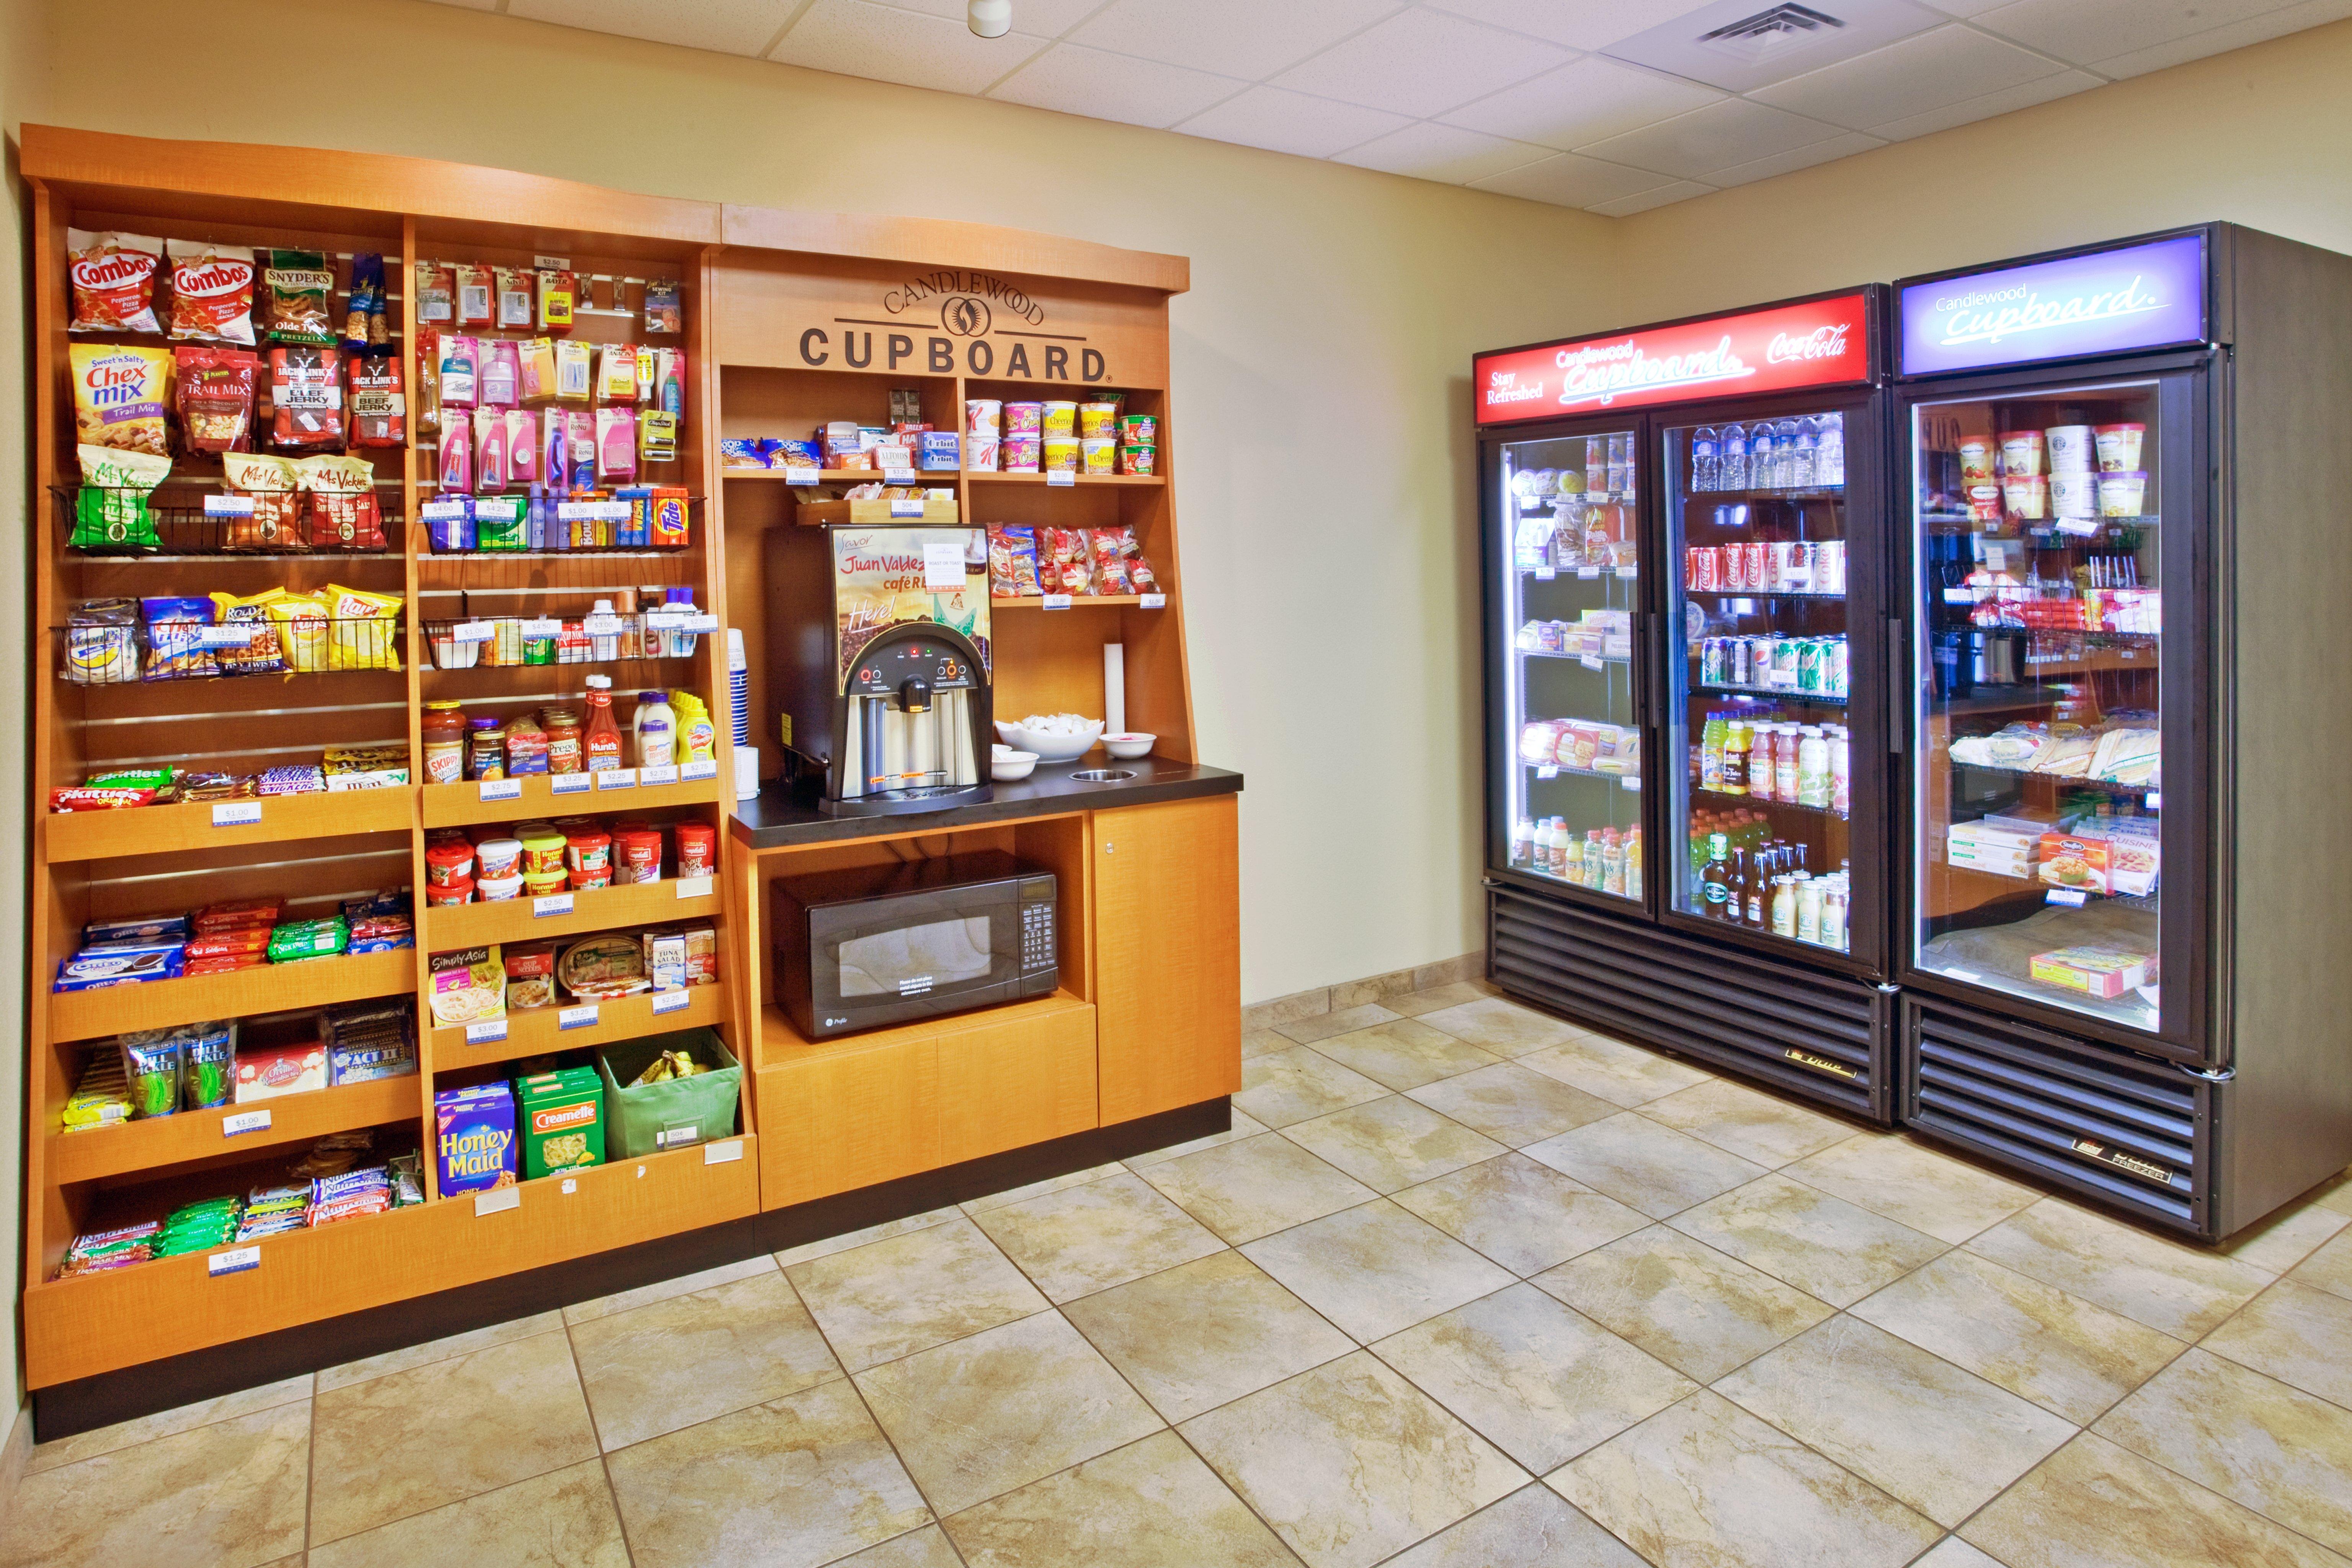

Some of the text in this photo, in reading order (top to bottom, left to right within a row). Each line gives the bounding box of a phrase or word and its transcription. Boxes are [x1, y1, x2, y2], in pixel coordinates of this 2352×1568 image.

[77, 256, 152, 286] Combos
[268, 270, 330, 284] SNYDER'S
[177, 265, 248, 292] Combos
[884, 271, 1044, 326] CANDLEWOOD
[1935, 283, 2027, 312] Candlewood
[208, 301, 237, 311] Pepperoni
[275, 322, 299, 331] Olde
[281, 333, 322, 342] PRETZELS
[1767, 323, 1851, 365] Coca-Cola
[124, 355, 145, 364] Salty
[799, 328, 1105, 382] CUPBOARD
[1556, 340, 1633, 368] Candlewood
[86, 364, 148, 388] Chex
[352, 375, 399, 385] JACK LINK'S
[1491, 373, 1516, 388] Stay
[93, 379, 145, 405] mix
[186, 383, 247, 396] TRAIL MIX
[1487, 383, 1543, 405] Refreshed
[113, 405, 155, 417] Trail Mix
[969, 406, 983, 431] K
[1050, 416, 1072, 425] Cheerios
[928, 439, 956, 448] Orbit
[881, 451, 908, 460] ALTOIDS
[980, 442, 997, 466] K
[336, 469, 367, 490] Vickie's
[217, 498, 241, 506] $2.50
[486, 504, 506, 512] $4.25
[661, 500, 684, 532] Tide
[1588, 531, 1608, 540] Raisin
[840, 534, 873, 555] Savor
[840, 555, 879, 574] Juan
[1726, 547, 1740, 586] Coca-Cola
[1746, 546, 1759, 586] Coca-Cola
[848, 596, 896, 631] Here!
[464, 627, 484, 635] $1.00
[296, 640, 325, 649] Classic
[591, 742, 618, 751] Hunt's
[691, 735, 712, 746] French's
[549, 743, 576, 755] Prego
[431, 755, 459, 772] SKIPPY
[2038, 754, 2090, 769] CHEESEBURGER
[94, 769, 161, 783] Skittles
[436, 765, 461, 781] Natural
[225, 809, 248, 817] $1.00
[1964, 832, 1985, 841] CUISINE
[2076, 829, 2157, 851] LEAN CUISINE
[542, 847, 564, 858] Hormel
[1963, 846, 1983, 855] CUISINE
[497, 854, 516, 864] Moore
[686, 857, 702, 866] Soup
[1964, 859, 1986, 869] CUISINE
[544, 898, 563, 906] $2.50
[113, 928, 140, 939] OREO
[74, 960, 122, 970] OREO
[518, 965, 542, 973] NOODLES
[85, 980, 116, 990] OREO
[662, 995, 679, 1003] $2.25
[188, 1052, 225, 1067] PICKLE
[352, 1051, 379, 1065] ACT
[133, 1062, 175, 1076] PICKLE
[269, 1064, 294, 1078] Orville
[534, 1083, 563, 1093] Creamette
[236, 1117, 259, 1126] $1.00
[536, 1104, 595, 1129] Creamette
[441, 1129, 513, 1157] Honey
[448, 1147, 503, 1178] Maid
[2112, 1156, 2164, 1180] FREEZER
[456, 1187, 480, 1196] HONEY
[224, 1252, 248, 1263] $1.25
